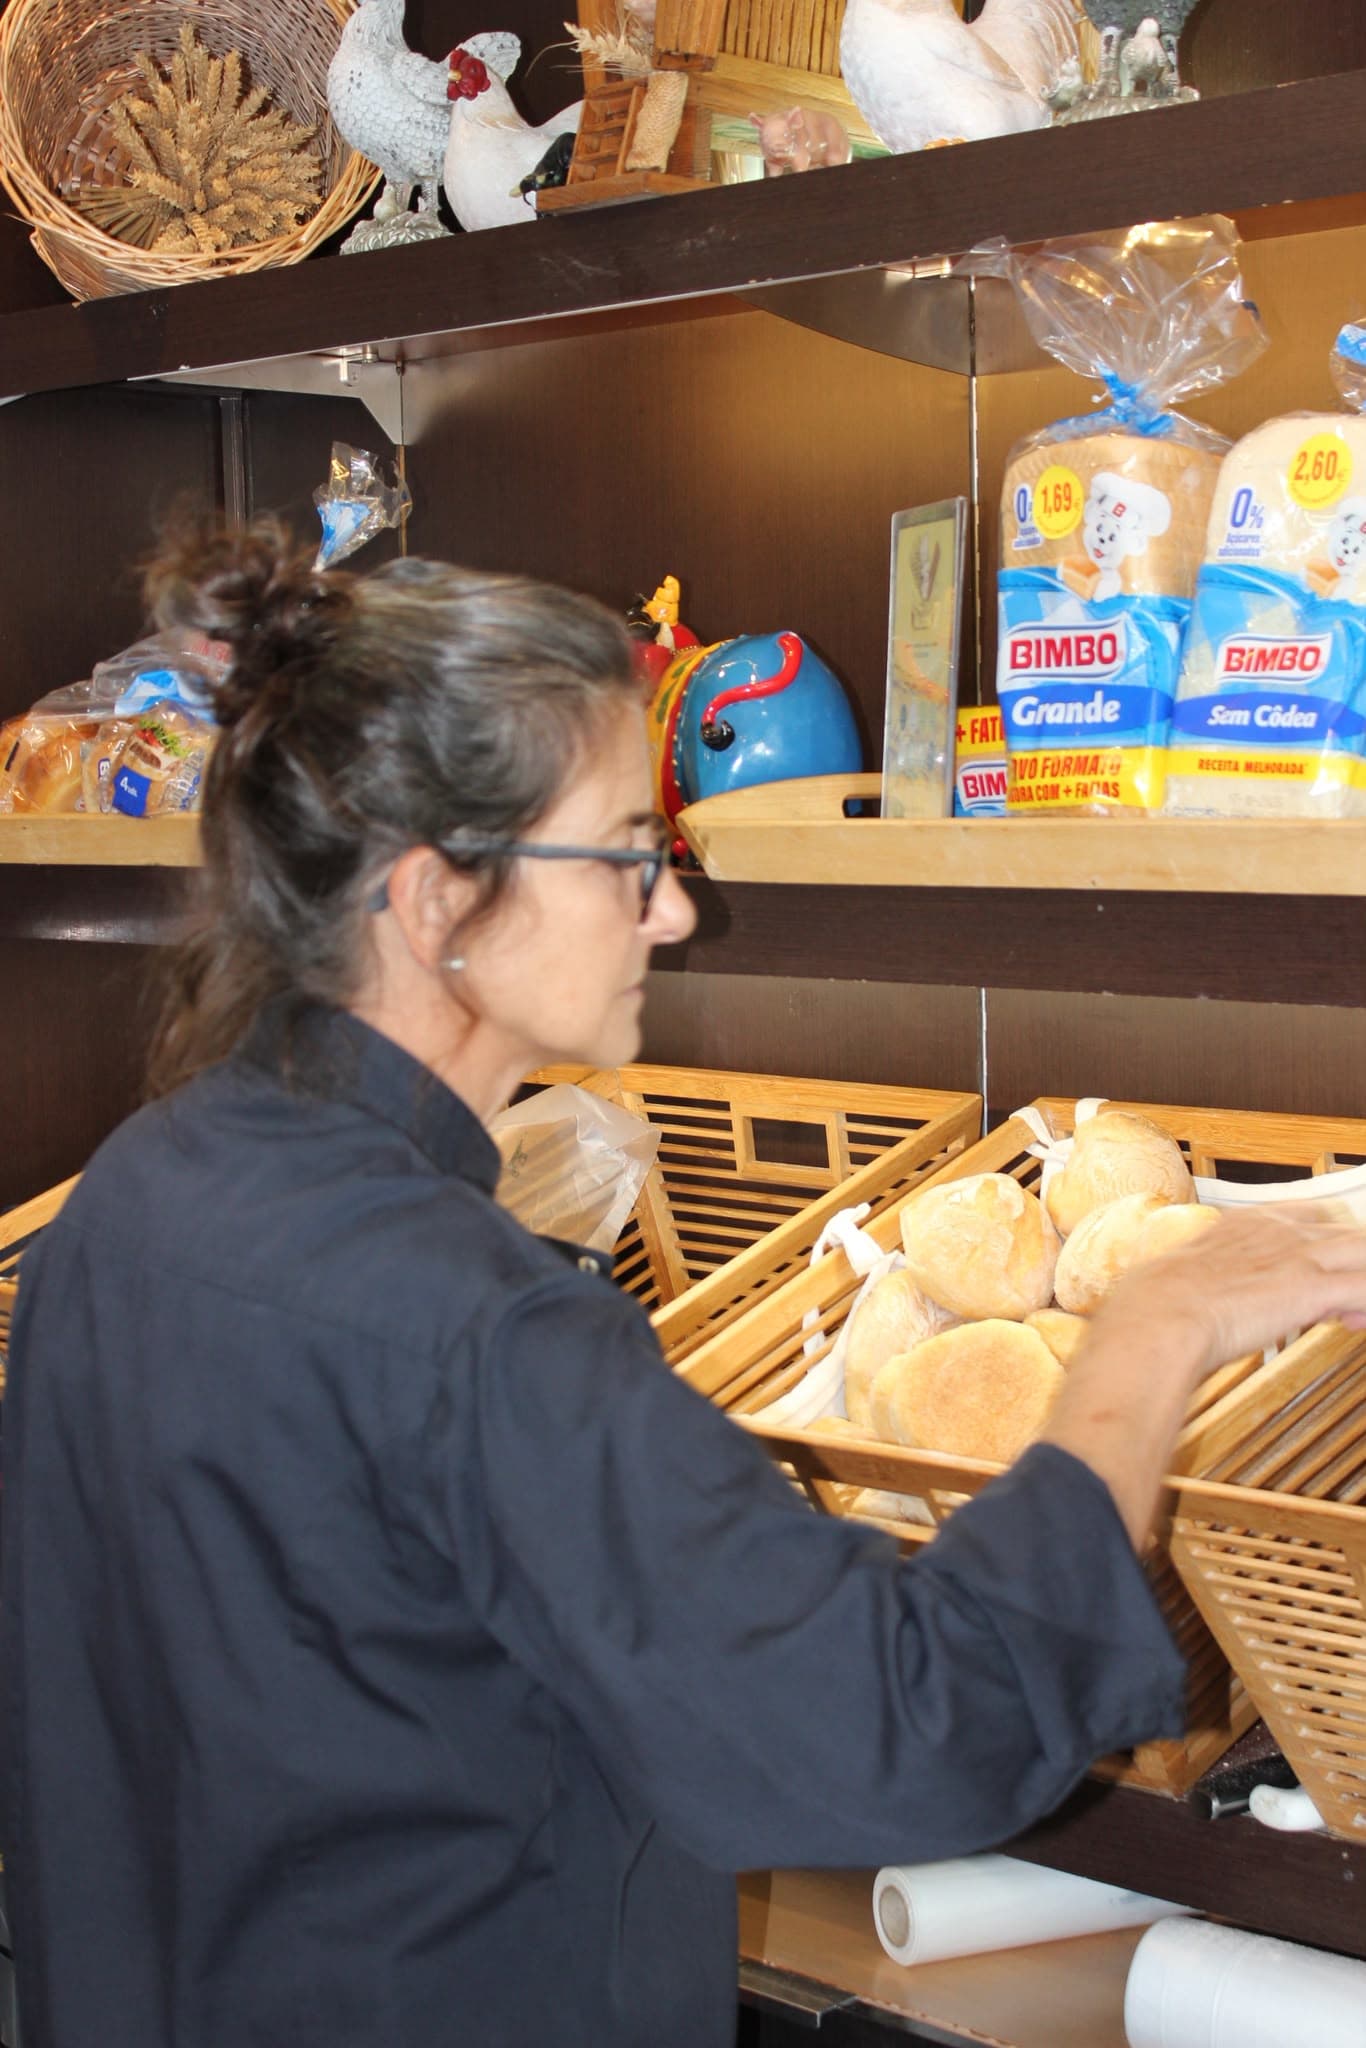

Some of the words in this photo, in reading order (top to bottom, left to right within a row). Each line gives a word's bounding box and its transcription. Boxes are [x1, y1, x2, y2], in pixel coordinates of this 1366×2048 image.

[1230, 487, 1265, 529] 0%
[1010, 632, 1117, 670] BIMBO
[1011, 689, 1121, 727] Grande
[1207, 704, 1249, 726] Sem
[1253, 704, 1318, 729] Côdea
[1198, 758, 1240, 772] RECEITA
[1243, 761, 1305, 775] MELHORADA
[1036, 783, 1060, 801] COM
